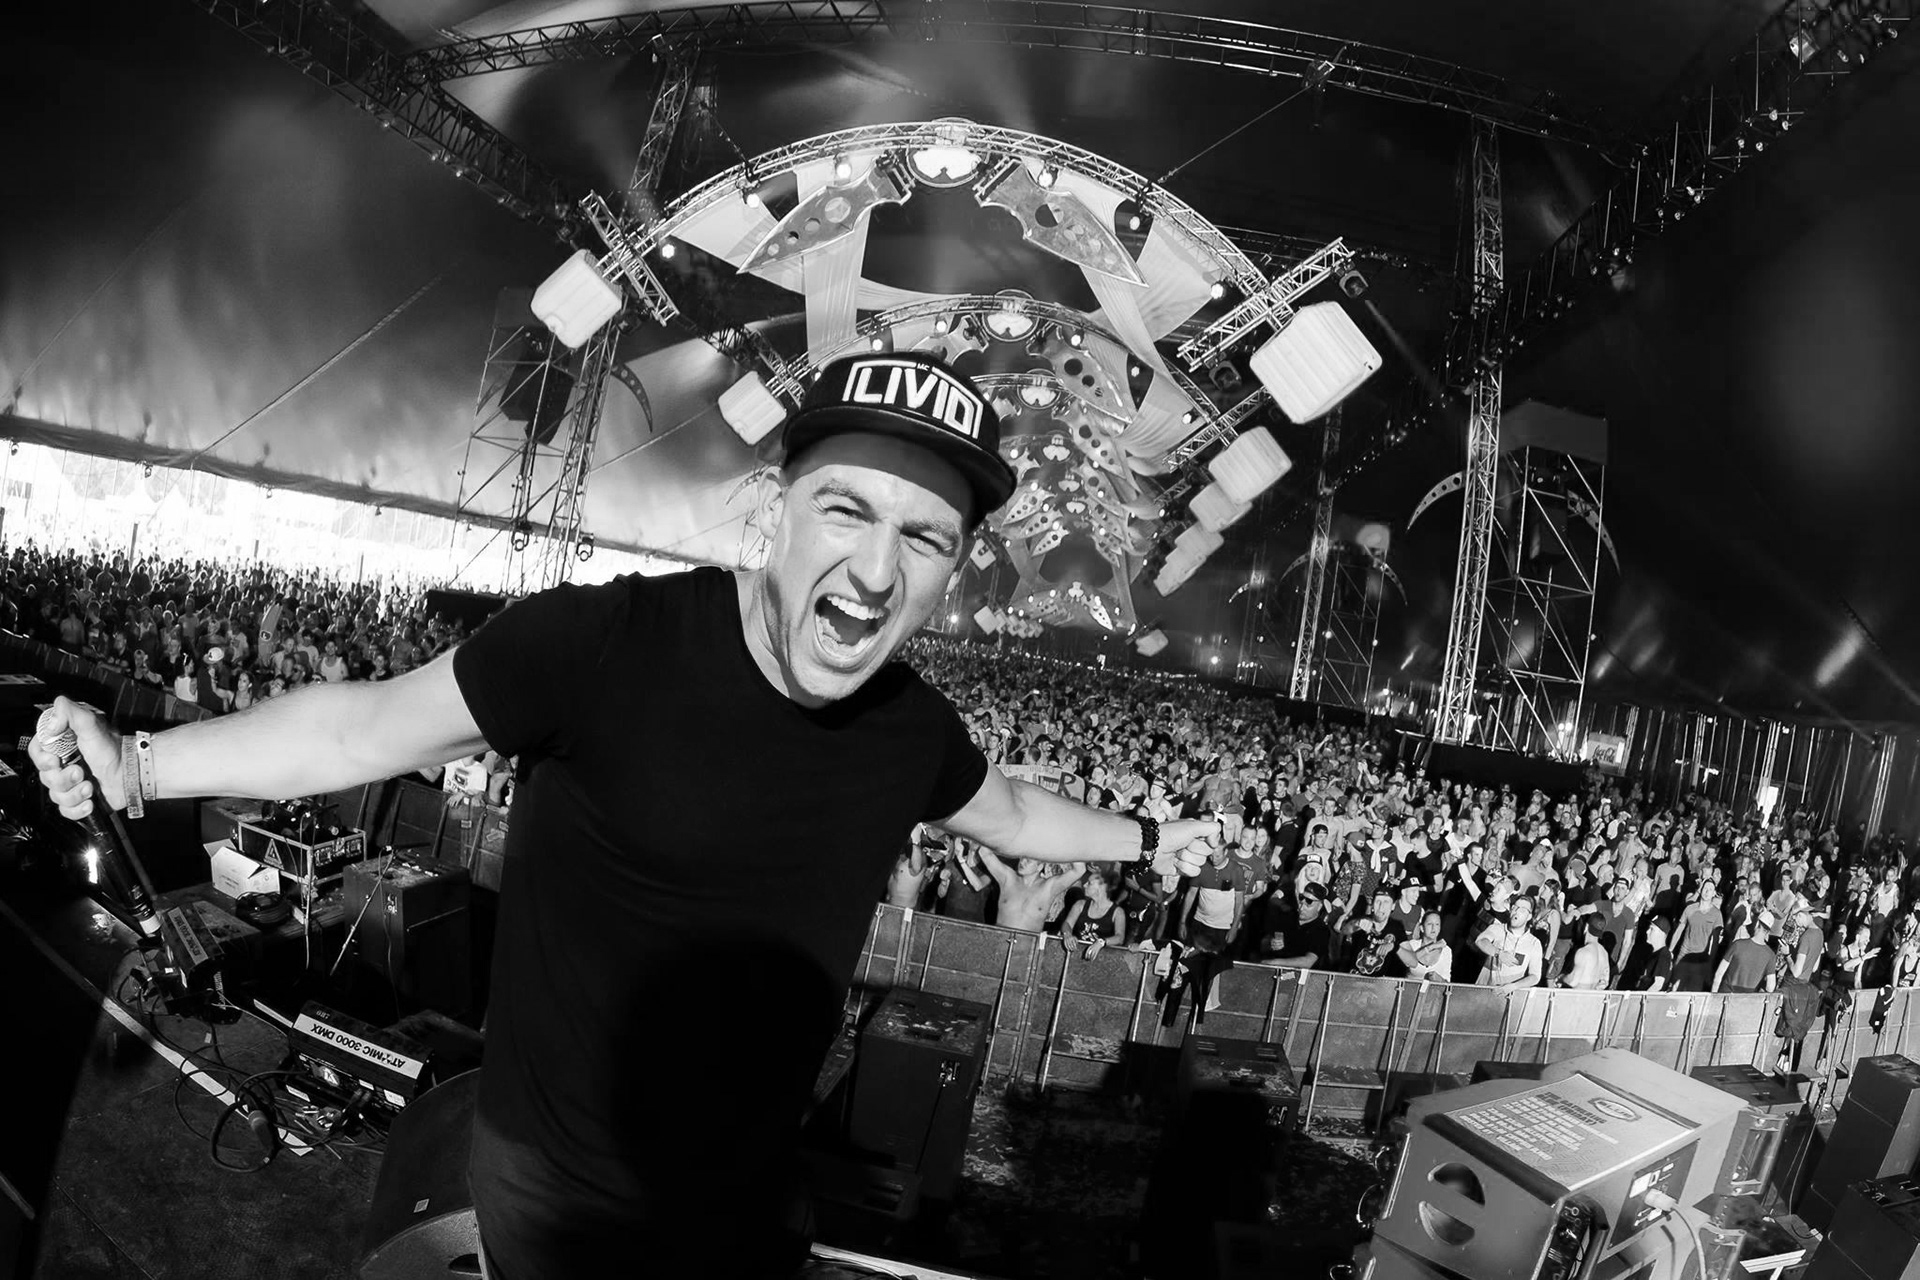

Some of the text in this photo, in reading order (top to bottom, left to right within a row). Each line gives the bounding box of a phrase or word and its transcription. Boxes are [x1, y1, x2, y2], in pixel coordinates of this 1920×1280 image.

[917, 363, 930, 371] MC
[853, 367, 975, 435] LIVID
[310, 1023, 336, 1040] DMX
[335, 1036, 362, 1051] 3000
